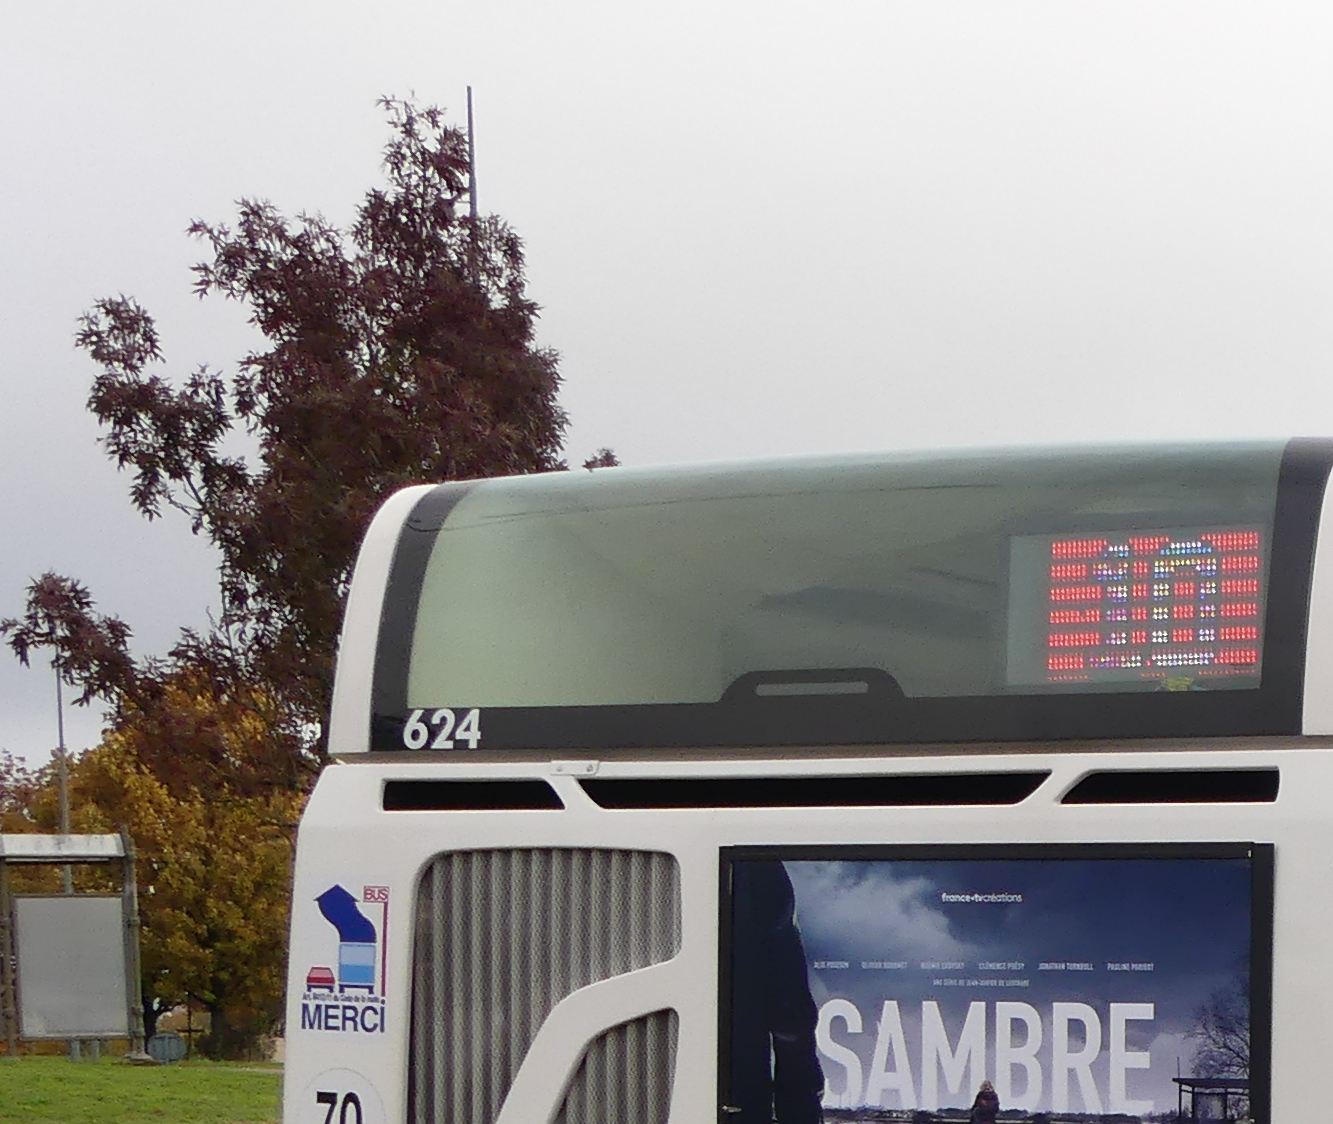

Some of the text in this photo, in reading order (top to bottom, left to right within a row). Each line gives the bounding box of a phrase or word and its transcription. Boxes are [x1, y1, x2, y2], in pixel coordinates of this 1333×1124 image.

[403, 708, 481, 750] 624
[363, 888, 389, 900] BUS
[301, 1000, 385, 1033] MERCI
[815, 999, 1156, 1114] SAMBRE
